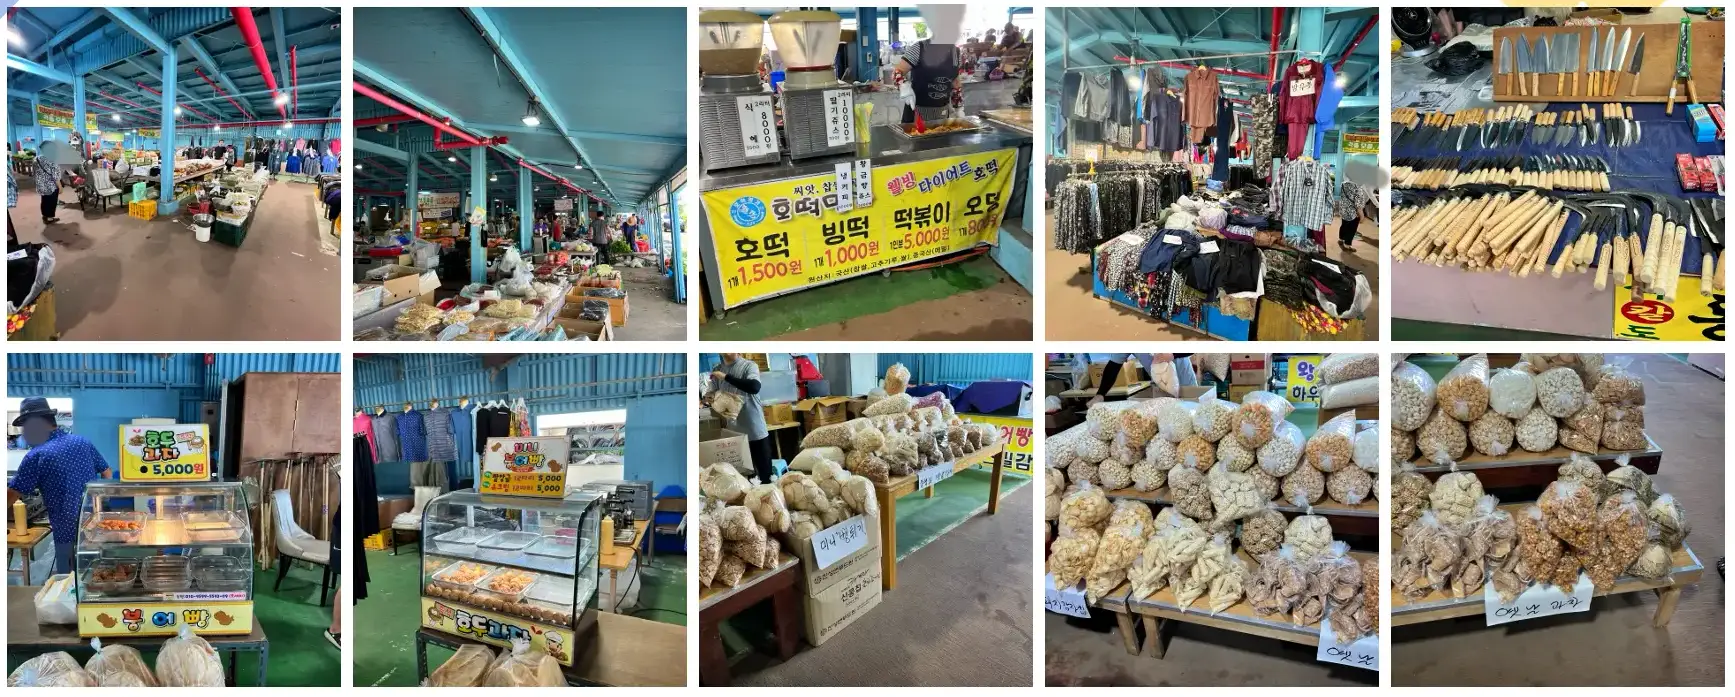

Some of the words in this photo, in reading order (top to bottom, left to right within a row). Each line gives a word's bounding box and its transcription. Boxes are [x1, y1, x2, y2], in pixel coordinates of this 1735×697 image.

[887, 171, 917, 196] 웰빙
[918, 160, 972, 193] 다이어트
[973, 159, 999, 182] 호떡
[894, 201, 951, 230] 떡볶이
[822, 215, 869, 246] 빙떡
[903, 226, 950, 250] 5,000원
[735, 232, 790, 262] 호떡
[824, 240, 880, 268] 1,000원
[737, 259, 803, 286] 1,500원
[1297, 361, 1315, 382] 왕
[145, 430, 176, 448] 호두
[514, 442, 539, 452] 미니
[142, 447, 181, 461] 과자
[504, 453, 545, 470] 붕어빵
[153, 463, 204, 476] 5,000원
[538, 475, 562, 484] 5,000
[537, 485, 561, 494] 5,000
[456, 609, 532, 641] 호두과자
